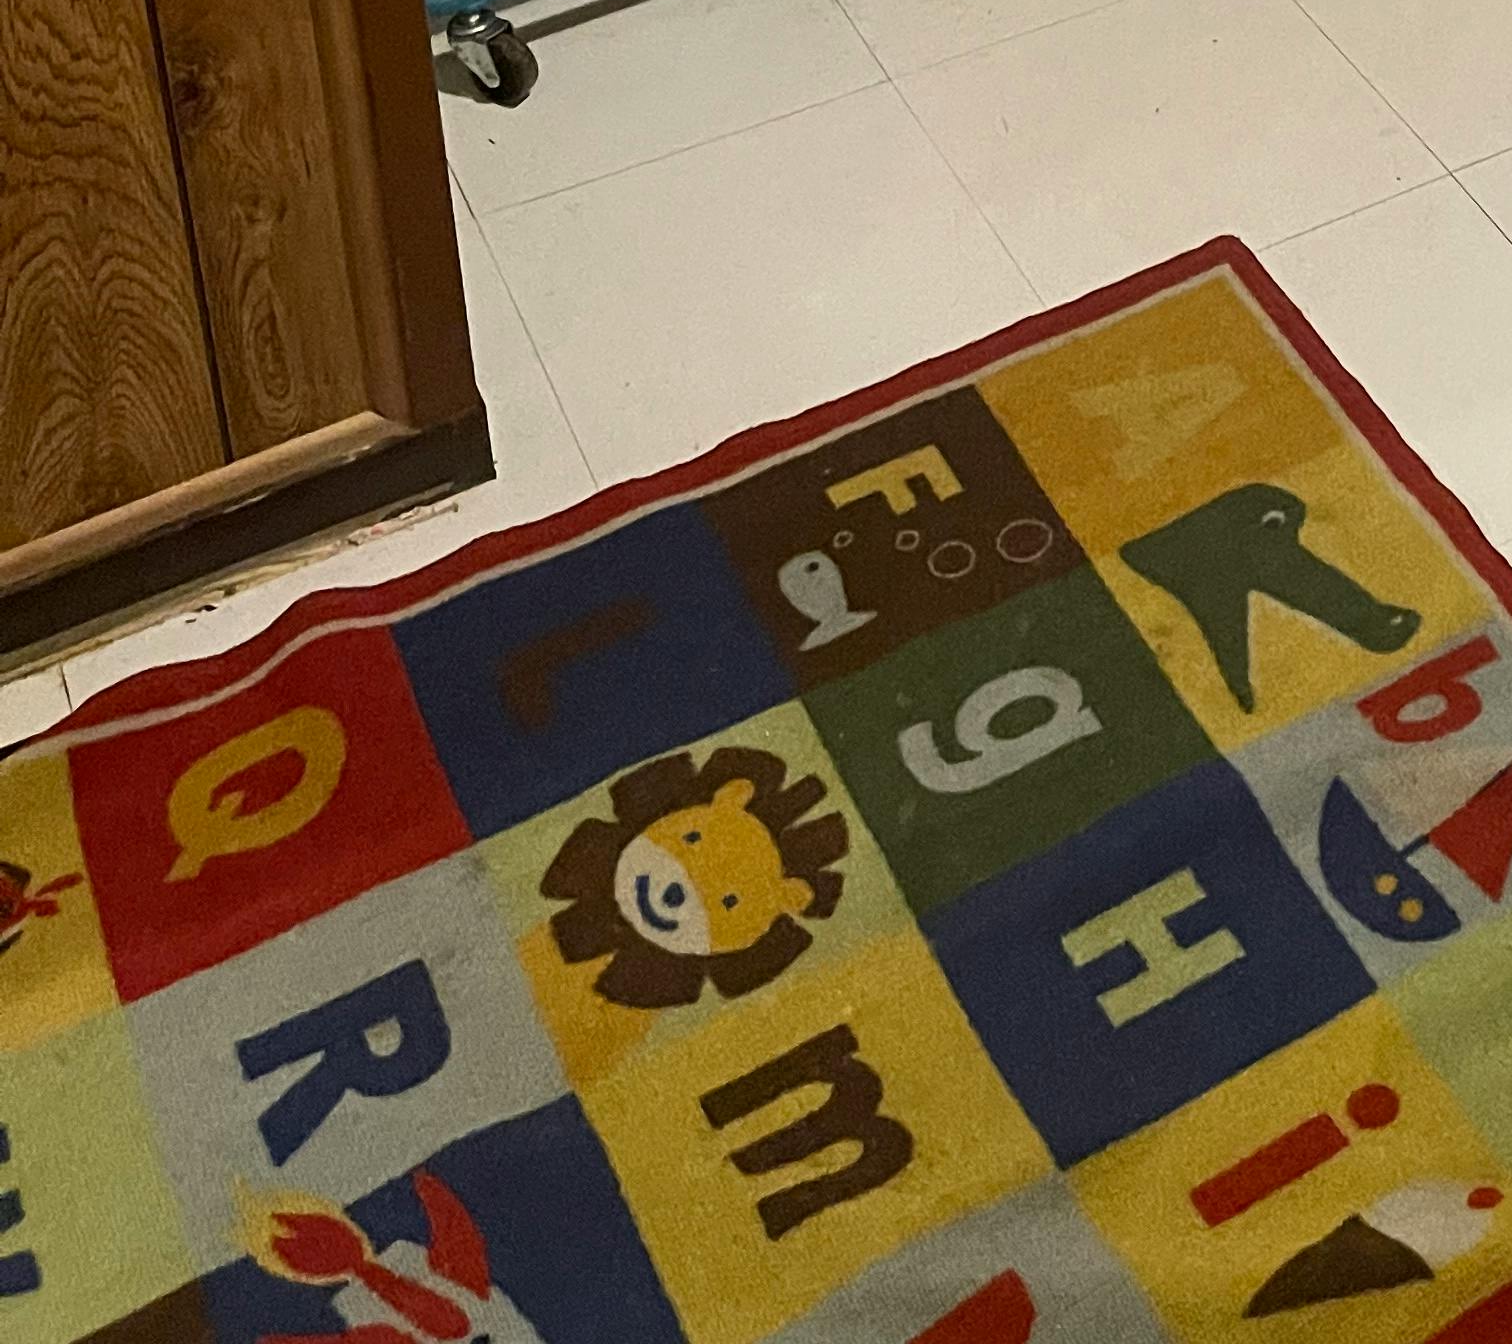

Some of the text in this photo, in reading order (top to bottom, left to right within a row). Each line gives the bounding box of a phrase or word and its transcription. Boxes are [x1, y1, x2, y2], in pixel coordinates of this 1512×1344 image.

[824, 444, 965, 515] F
[1068, 362, 1251, 481] A
[898, 665, 1103, 794] g
[1355, 634, 1499, 744] b
[166, 704, 348, 881] Q
[1061, 867, 1247, 1029] H
[237, 957, 453, 1167] R
[699, 1023, 915, 1242] m
